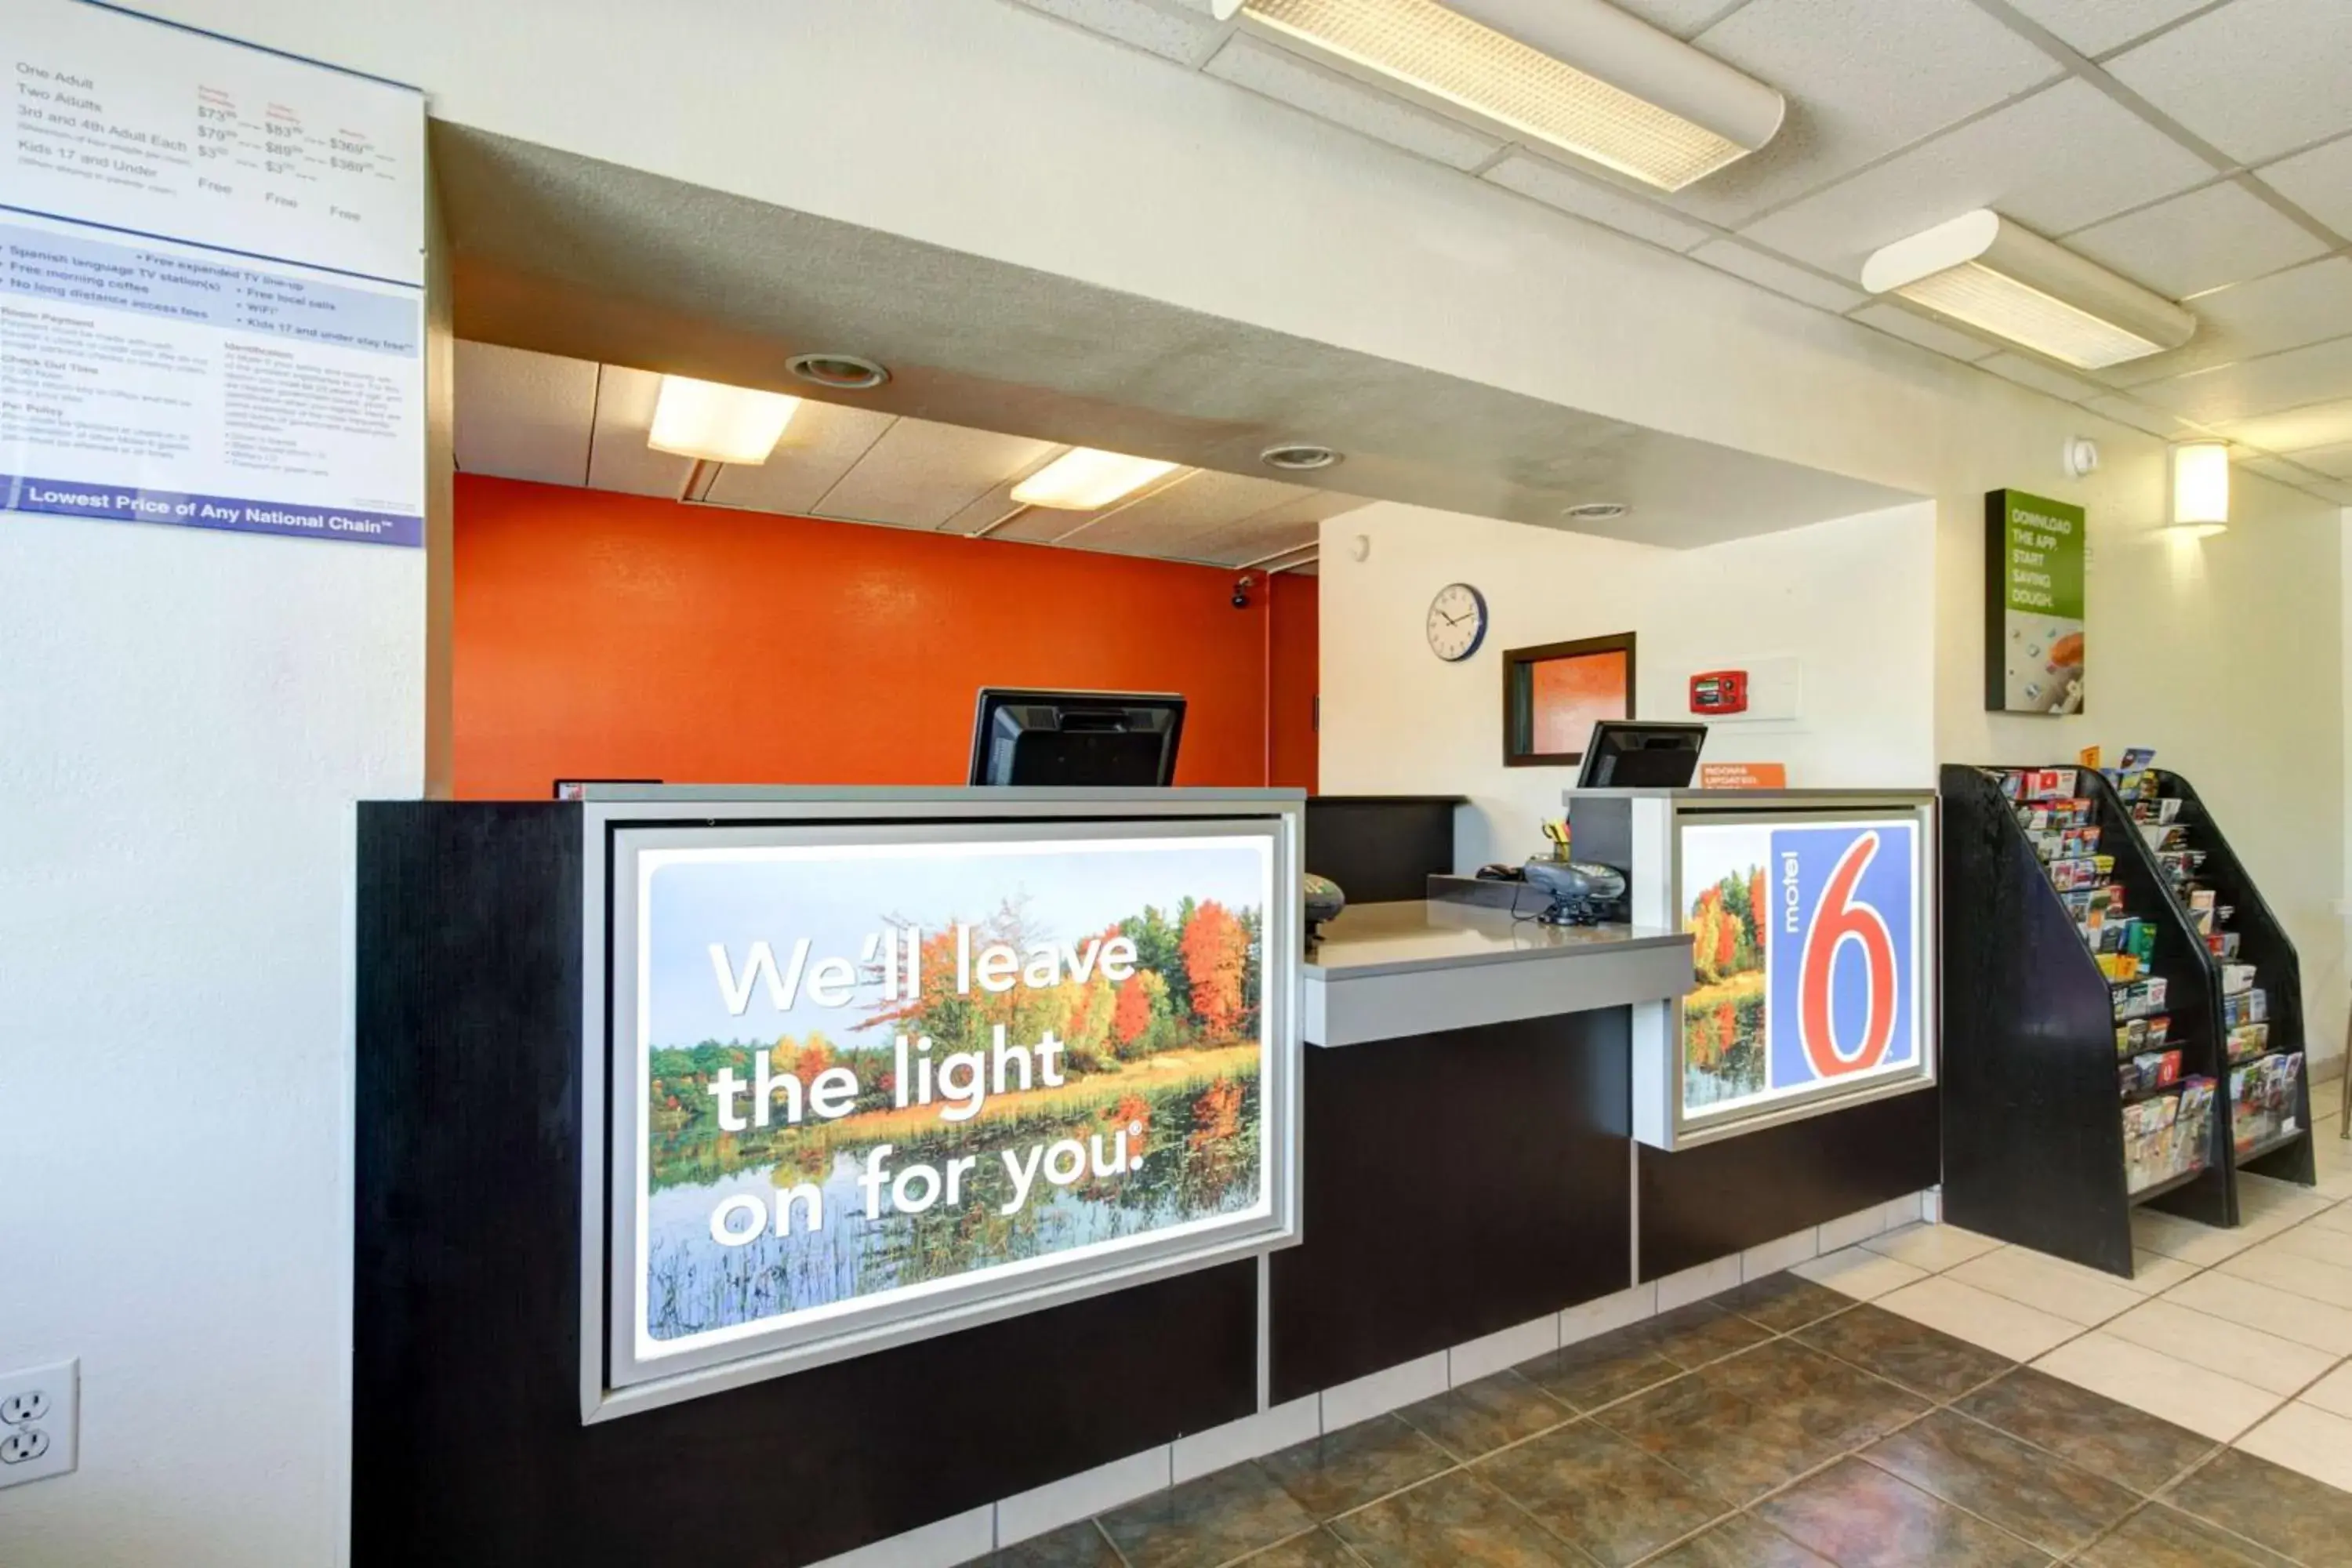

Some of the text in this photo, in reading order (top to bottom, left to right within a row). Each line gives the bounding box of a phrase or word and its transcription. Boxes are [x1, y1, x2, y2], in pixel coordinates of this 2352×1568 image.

[16, 62, 93, 90] One Adult
[16, 82, 103, 113] Two Adults
[17, 103, 187, 153] 3rd and 4th Adult Each
[18, 140, 158, 177] Kids 17 and Under
[198, 176, 234, 194] Free
[265, 191, 299, 209] Free
[329, 204, 362, 223] Free
[9, 245, 222, 292] Spanish language TV station(s)
[10, 261, 150, 295] Free morning coffee
[144, 254, 305, 293] Free expanded TV line-up
[10, 277, 210, 319] No long distance access fees
[246, 287, 336, 312] Free local calls
[41, 315, 95, 329] Payment
[246, 317, 274, 331] Kids
[278, 323, 295, 334] 17
[296, 326, 318, 338] and
[320, 332, 356, 343] under
[357, 336, 381, 350] stay
[26, 403, 64, 418] Policy
[29, 486, 110, 510] Lowest
[115, 495, 171, 516] Price
[175, 502, 197, 517] of
[200, 503, 240, 524] Any
[245, 508, 324, 529] National
[2012, 507, 2072, 535] DOWNLOAD
[2012, 528, 2034, 546] THE
[2013, 549, 2045, 567] START
[2012, 568, 2051, 589] SAVING
[1780, 851, 1799, 934] motel
[709, 924, 1138, 1017] We'll leave
[1797, 829, 1898, 1080] 6
[708, 1025, 1065, 1134] the light
[710, 1179, 823, 1247] on
[858, 1145, 977, 1221] for
